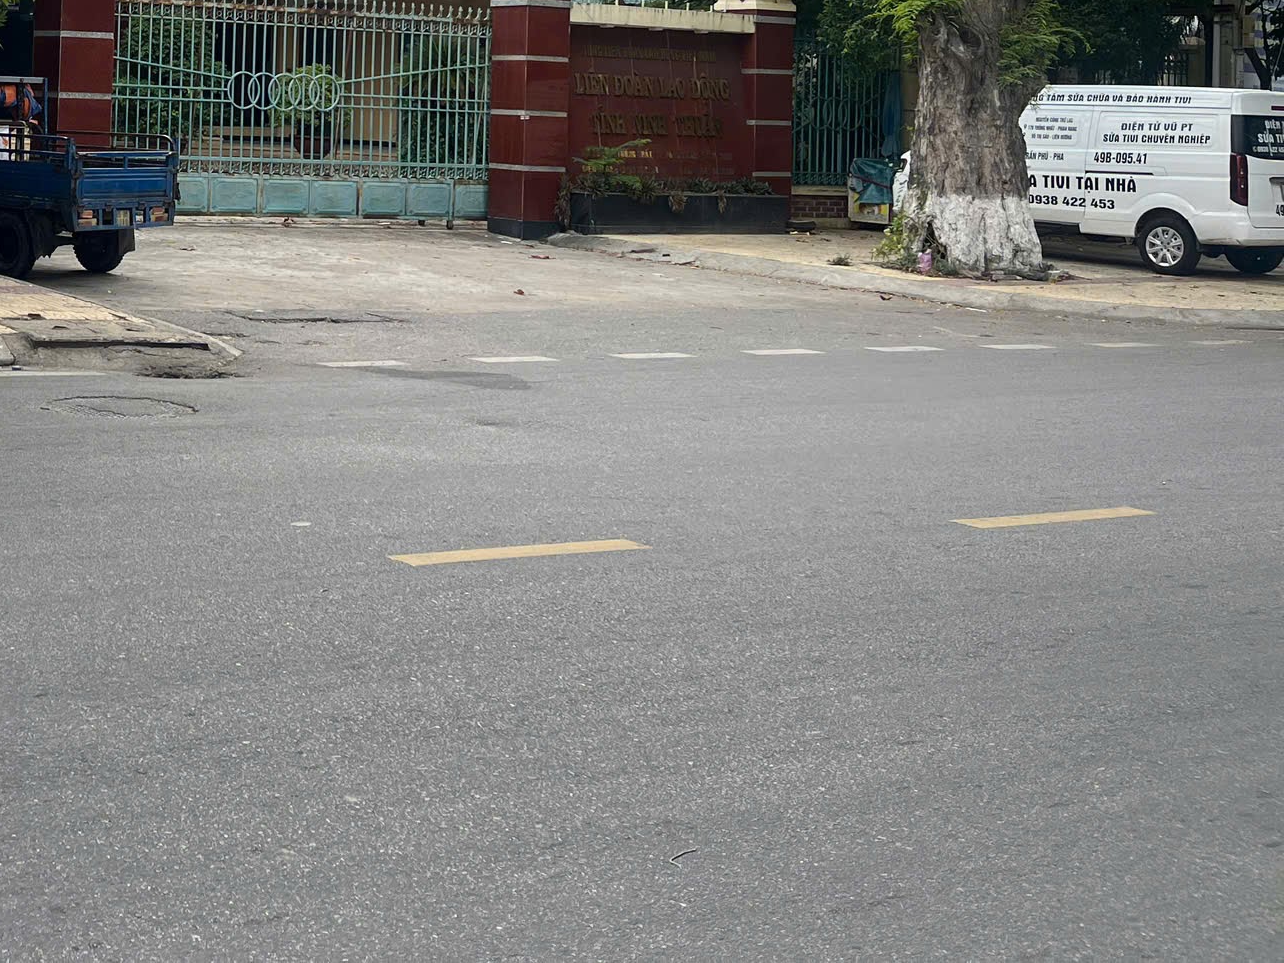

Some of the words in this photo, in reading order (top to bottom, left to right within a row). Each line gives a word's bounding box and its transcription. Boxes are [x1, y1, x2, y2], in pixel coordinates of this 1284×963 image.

[573, 68, 611, 95] LIÊN
[613, 71, 654, 98] ĐOÀN
[658, 76, 685, 99] LAO
[1047, 93, 1065, 102] TÂM
[1067, 92, 1084, 102] SỬA
[1086, 92, 1110, 102] CHỮA
[1112, 93, 1123, 102] VÀ
[1146, 94, 1172, 104] HÀNH
[1174, 96, 1192, 104] TIVI
[1121, 121, 1145, 133] ĐIỆN
[1148, 121, 1161, 131] TỬ
[1163, 121, 1178, 131] VŨ
[1181, 123, 1194, 132] PT
[1102, 131, 1120, 143] SỬA
[1122, 134, 1139, 143] TIVI
[1141, 133, 1175, 144] CHUYÊN
[1178, 133, 1211, 145] NGHIỆP
[1275, 133, 1284, 144] TI
[1093, 151, 1148, 165] 49B-095.41
[1042, 175, 1070, 189] TIVI
[1075, 176, 1099, 194] TẠI
[1105, 175, 1137, 193] NHÀ
[1028, 194, 1058, 205] 0938
[1062, 196, 1086, 208] 422
[1090, 198, 1115, 210] 453
